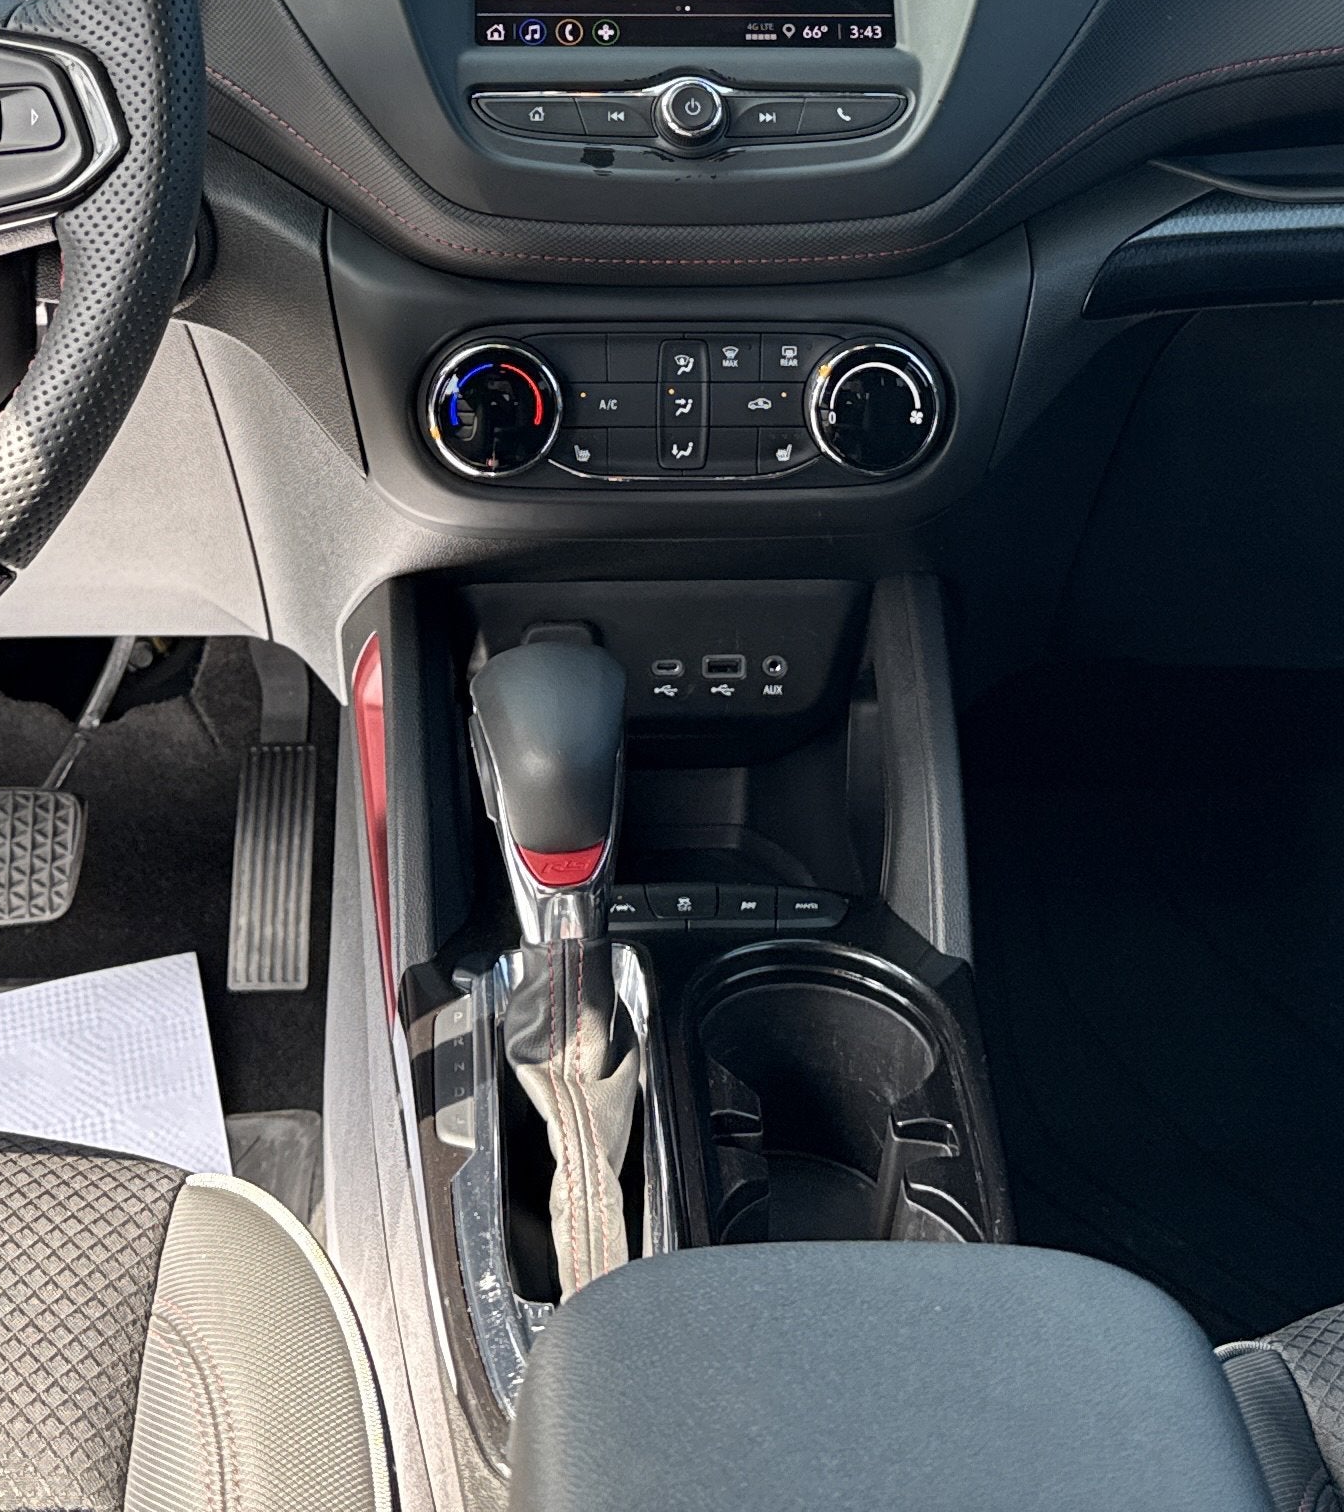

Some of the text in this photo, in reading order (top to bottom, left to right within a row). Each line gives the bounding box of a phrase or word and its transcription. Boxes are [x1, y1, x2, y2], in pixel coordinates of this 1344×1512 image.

[747, 23, 775, 31] 4G LTE
[849, 25, 883, 39] 3:43
[722, 359, 739, 368] MAX
[780, 359, 798, 368] REAR
[598, 399, 618, 411] A/C
[828, 410, 837, 425] 0
[762, 684, 784, 696] AUX
[453, 1011, 464, 1024] P
